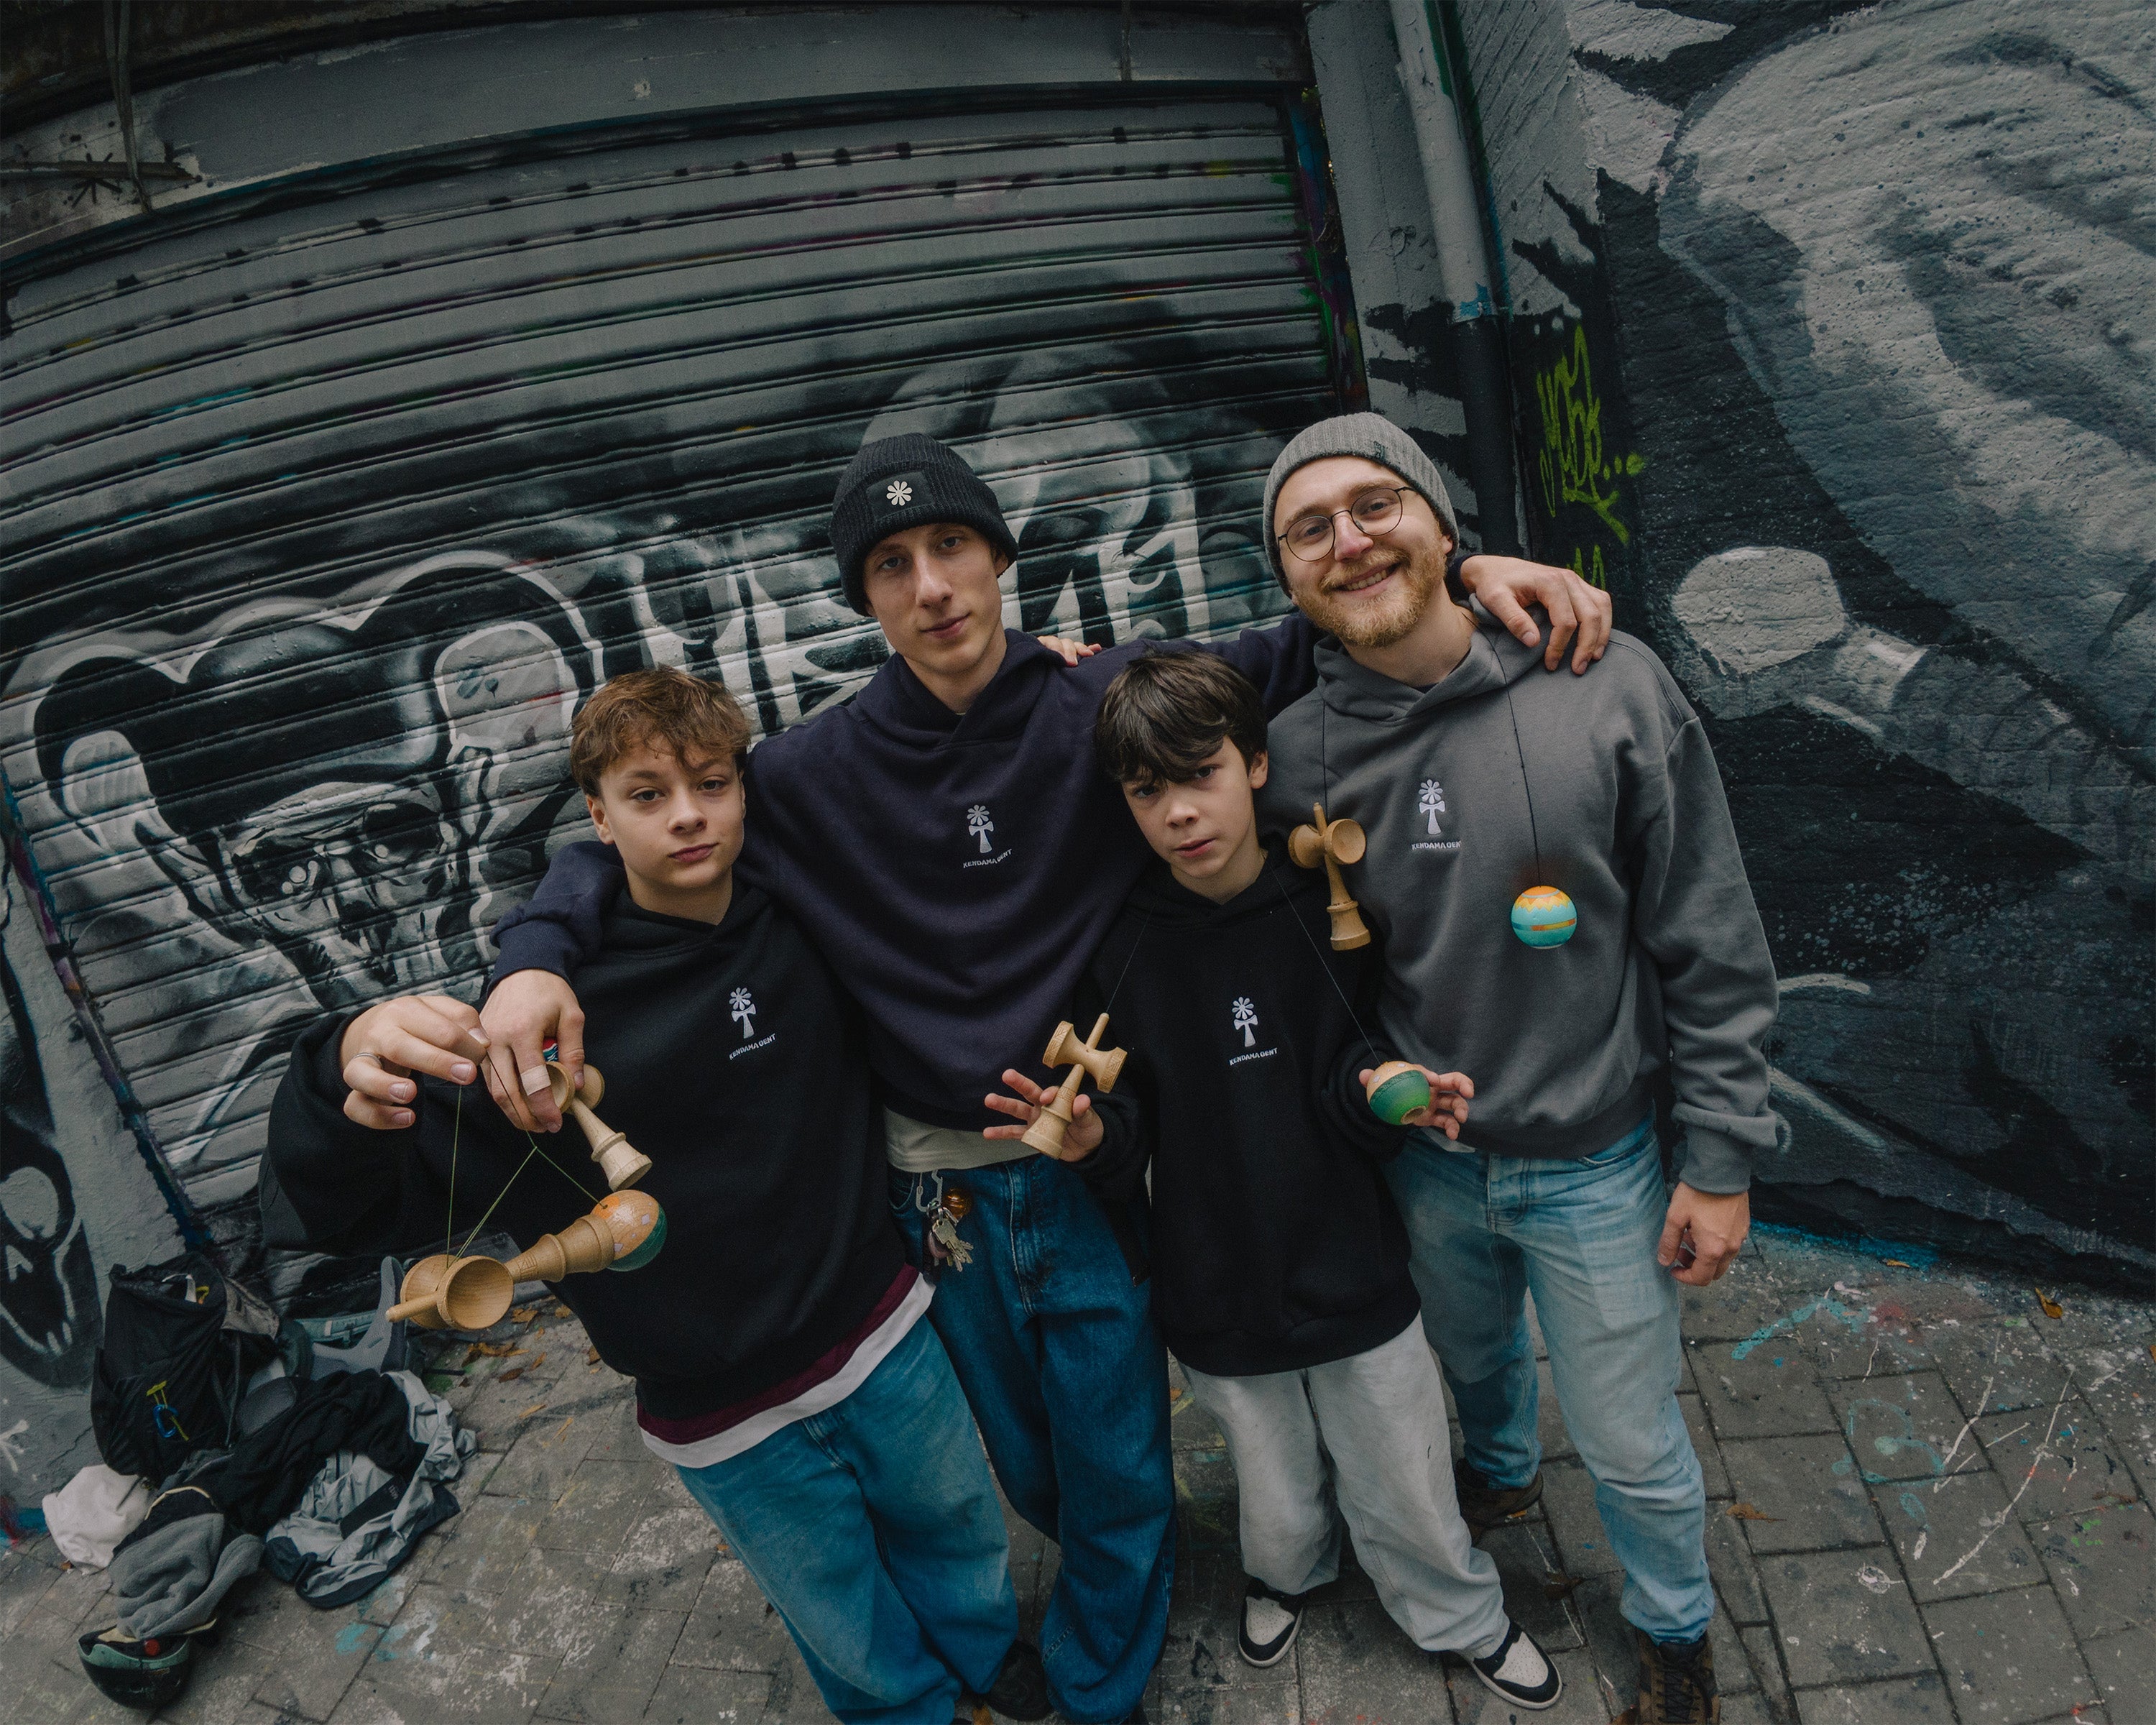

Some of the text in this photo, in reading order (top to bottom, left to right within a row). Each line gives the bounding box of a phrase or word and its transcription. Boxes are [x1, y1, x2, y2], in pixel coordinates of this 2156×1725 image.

[1411, 842, 1447, 850] KENDAMA
[963, 858, 998, 868] KENDAMA
[729, 1042, 760, 1060] KENDAMA
[1229, 1052, 1261, 1066] KENDAMA
